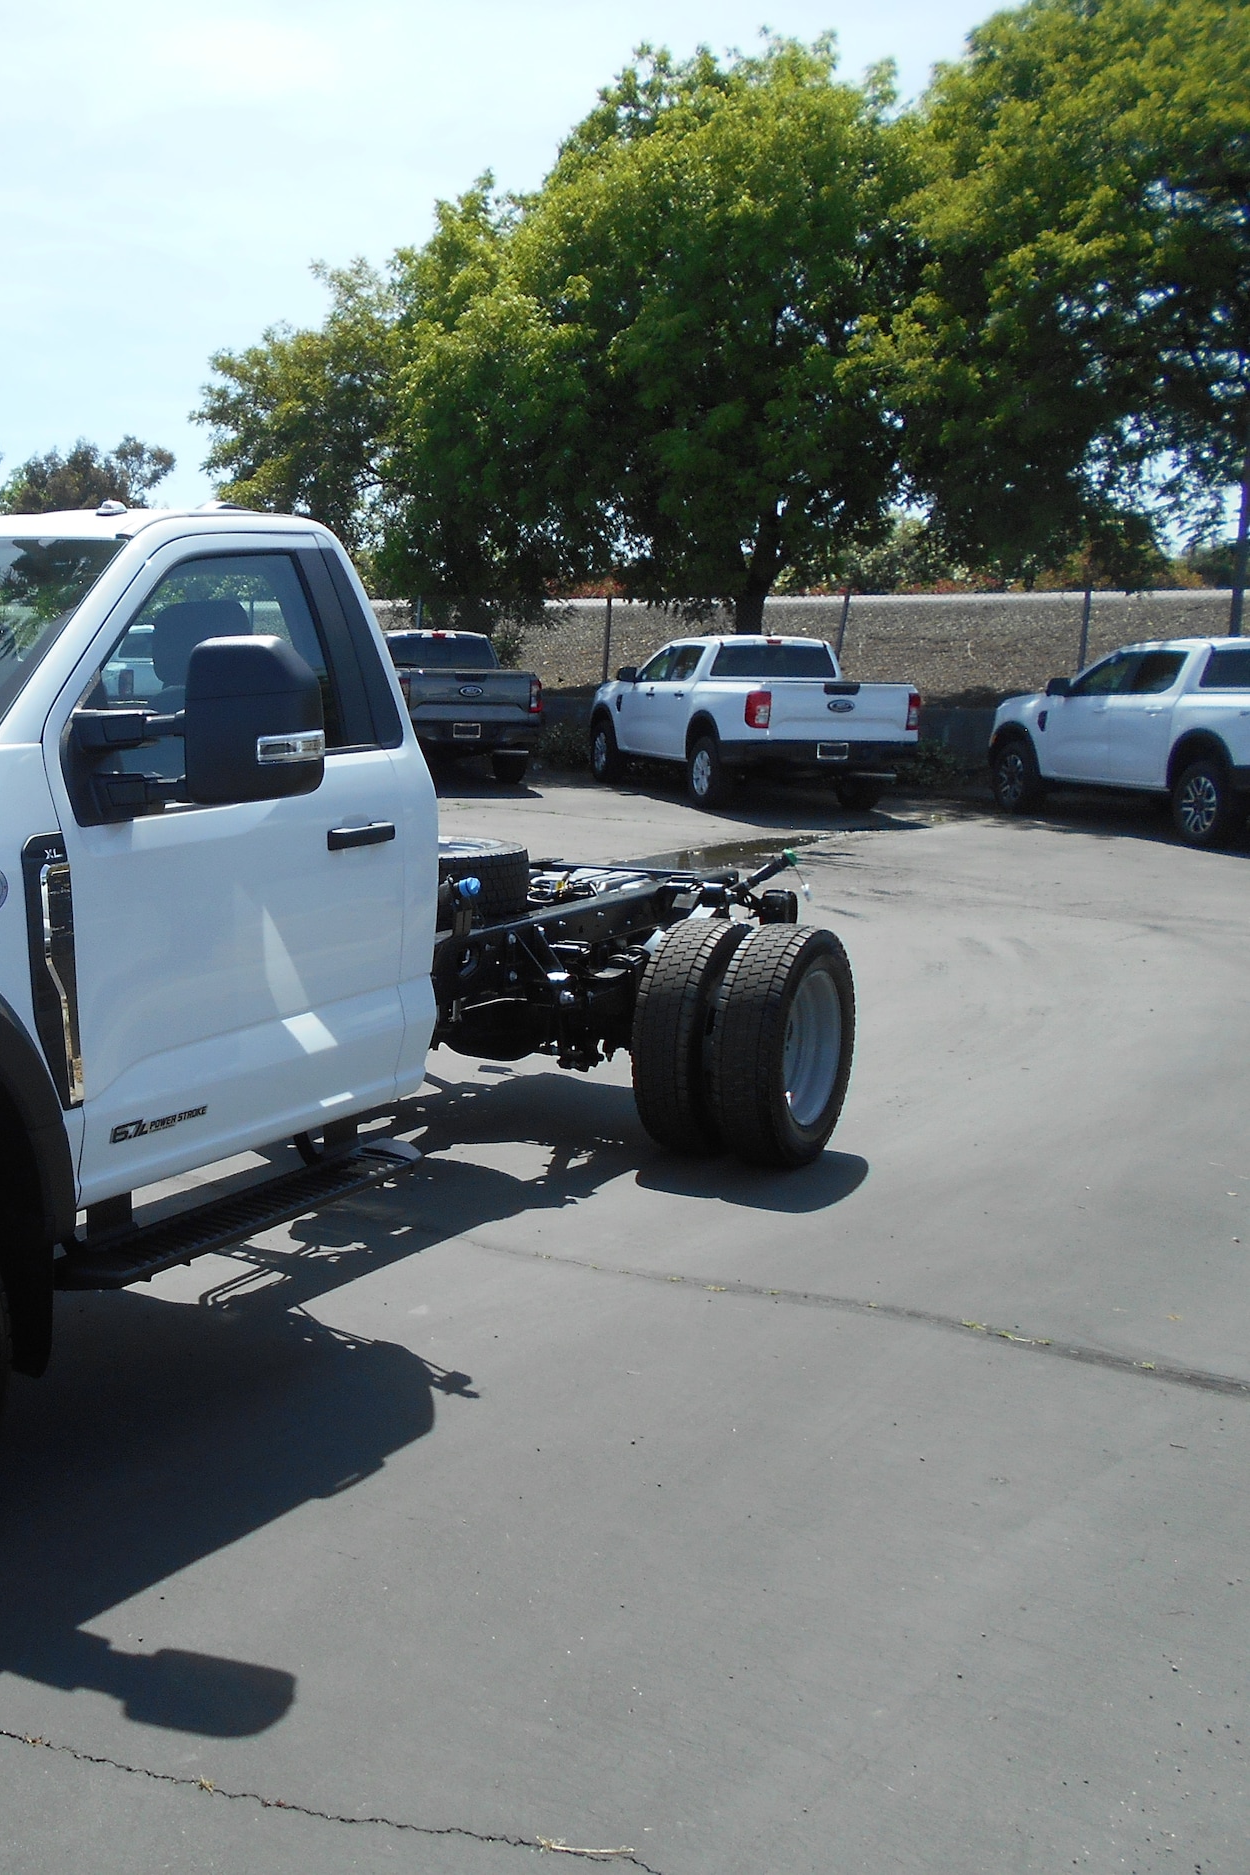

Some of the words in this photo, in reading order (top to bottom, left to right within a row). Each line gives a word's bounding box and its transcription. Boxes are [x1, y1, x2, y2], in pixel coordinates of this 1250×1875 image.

[44, 848, 63, 860] XL
[149, 1114, 177, 1130] POWER
[177, 1105, 208, 1122] STROKE
